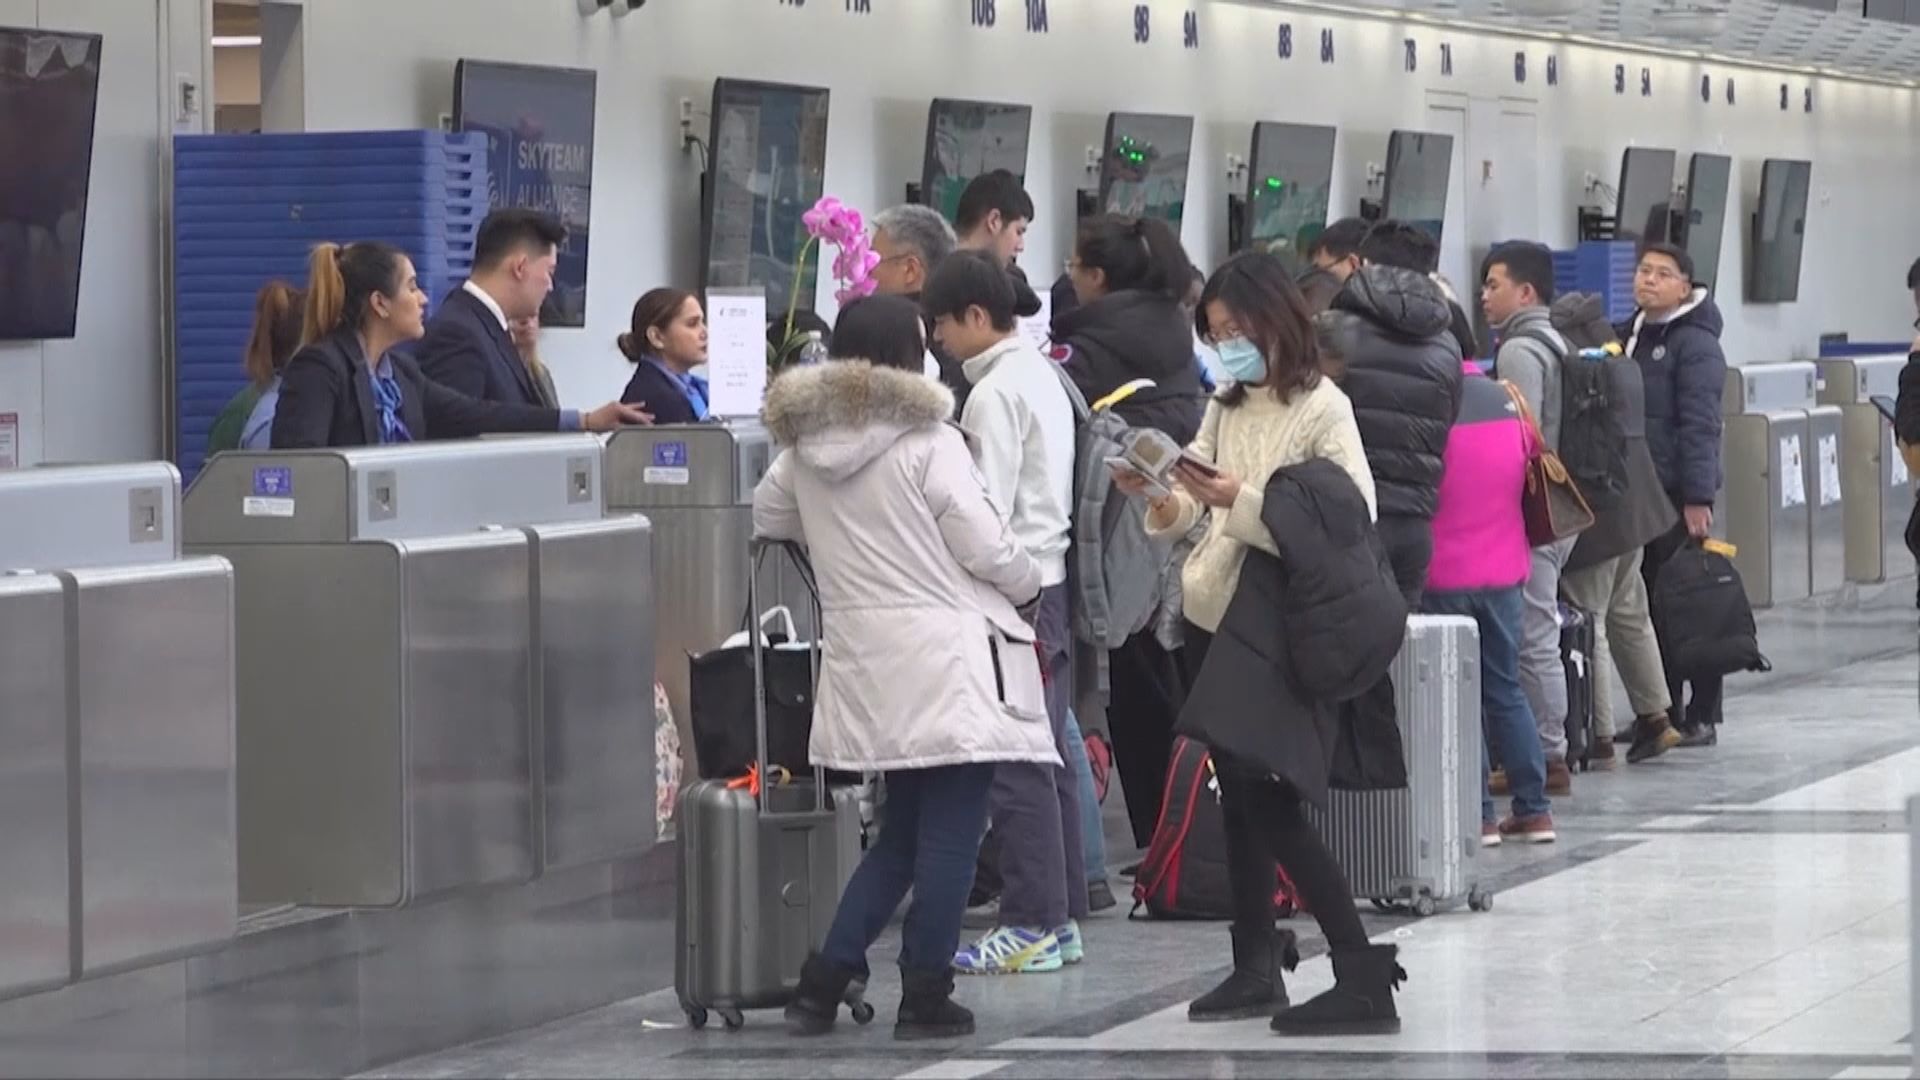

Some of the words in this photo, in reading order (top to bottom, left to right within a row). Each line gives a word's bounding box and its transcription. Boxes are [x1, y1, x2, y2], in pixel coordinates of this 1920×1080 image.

[1026, 0, 1048, 33] 10A
[1134, 6, 1149, 43] 9B
[1184, 11, 1198, 47] 9A
[1279, 24, 1292, 58] 8B
[1321, 29, 1334, 62] 8A
[1404, 39, 1415, 72] 7B
[1440, 43, 1452, 76] 7A
[518, 141, 585, 171] SKYTEAM
[516, 184, 578, 213] ALLIANCE
